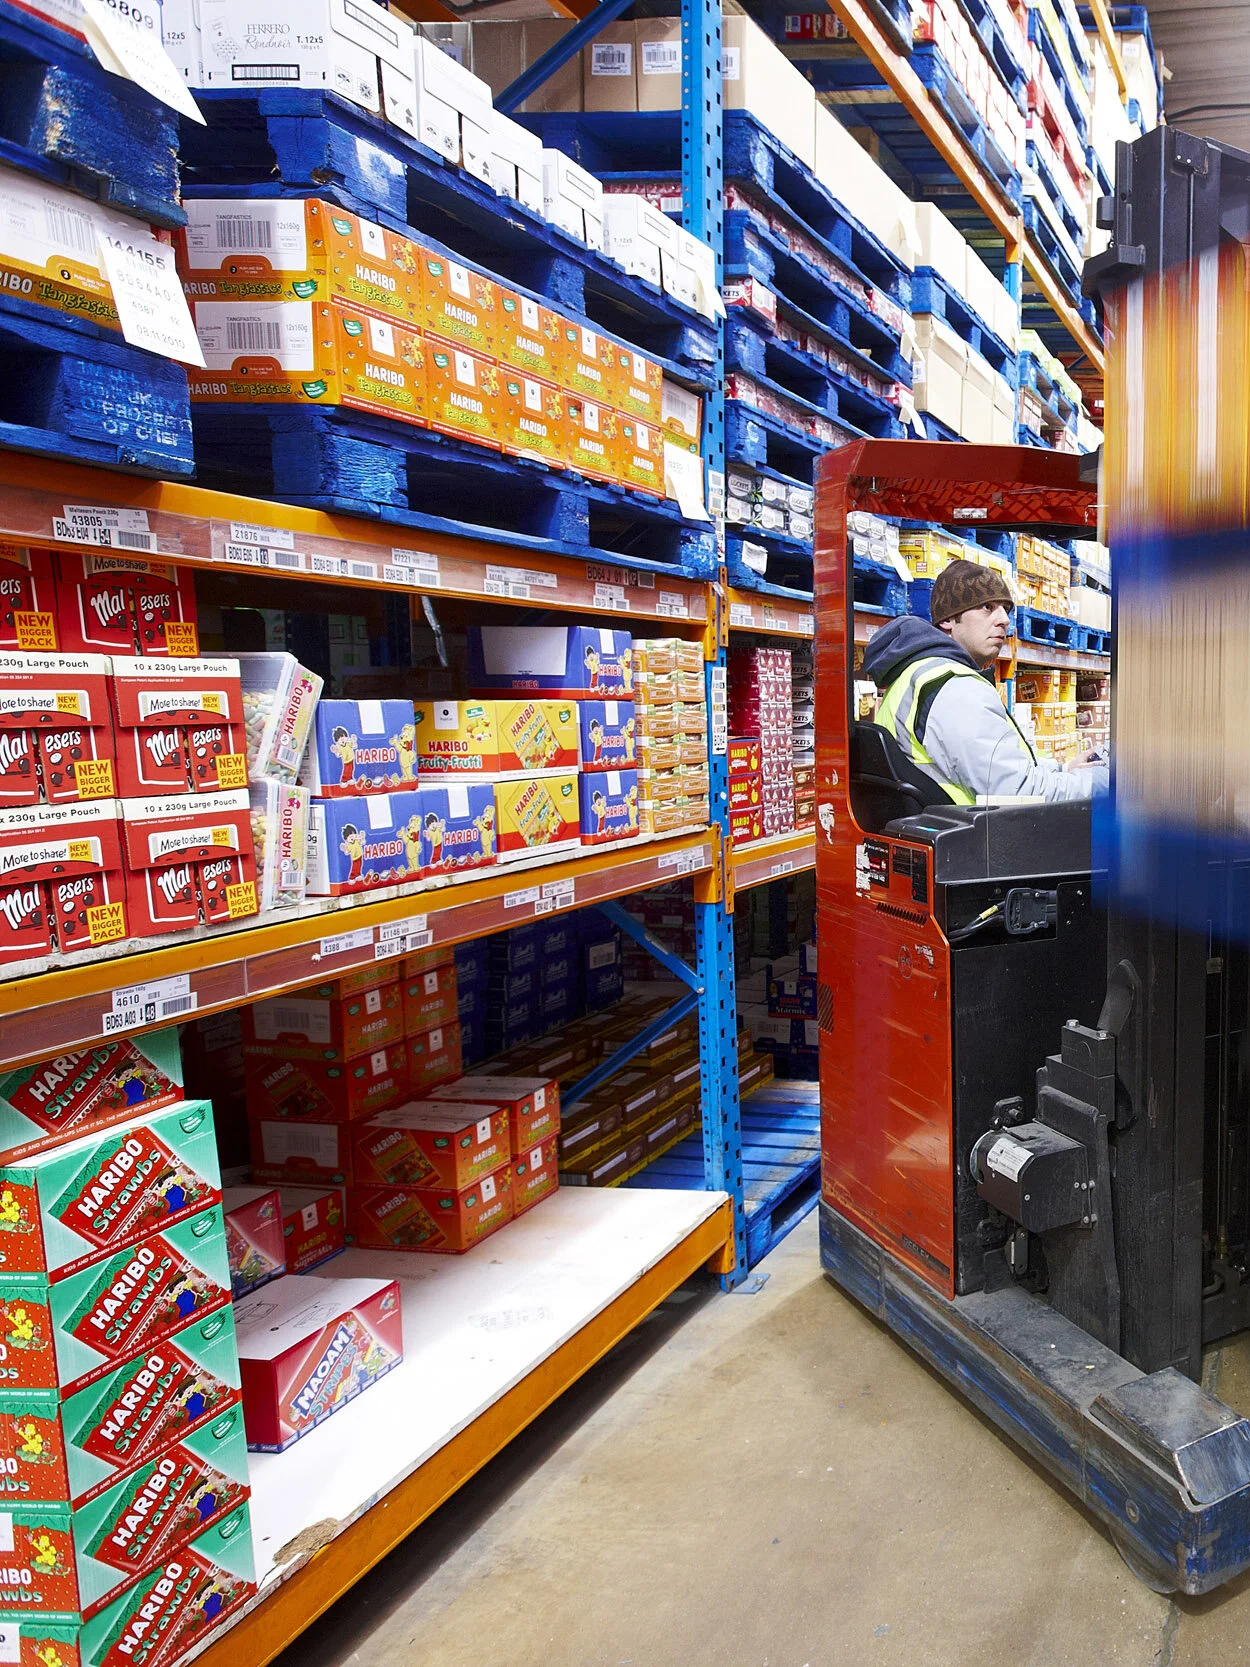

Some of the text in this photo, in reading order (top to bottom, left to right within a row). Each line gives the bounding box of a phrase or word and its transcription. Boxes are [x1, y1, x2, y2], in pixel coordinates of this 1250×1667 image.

[247, 24, 290, 34] FERRERO
[244, 34, 293, 50] Rondnoir
[305, 36, 324, 44] 12x5
[107, 236, 166, 270] 144155
[356, 264, 396, 291] HARIBO
[349, 278, 404, 310] Tangfastics
[444, 302, 478, 327] HARIBO
[516, 336, 544, 357] HARIBO
[365, 362, 404, 388] HARIBO
[188, 382, 292, 396] HARIBO Tangfastics
[357, 377, 413, 406] Tangfastics
[450, 392, 482, 414] HARIBO
[72, 516, 102, 526] 43805
[235, 530, 258, 541] 21876
[18, 613, 50, 627] NEW
[20, 628, 53, 638] BIGGER
[168, 624, 193, 636] NEW
[22, 636, 54, 648] PACK
[168, 636, 194, 646] BIGGER
[170, 644, 196, 654] PACK
[27, 658, 56, 668] Large
[59, 658, 89, 668] Pouch
[155, 664, 176, 672] 230g
[179, 664, 200, 673] Large
[204, 664, 228, 672] Pouch
[58, 695, 76, 704] NEW
[150, 698, 170, 711] More
[179, 697, 200, 708] share!
[284, 686, 304, 734] HARIBO
[510, 703, 536, 737] HARIBO
[514, 713, 544, 750] Fruity-Frutti
[428, 740, 468, 752] HARIBO
[219, 757, 242, 768] NEW
[356, 748, 396, 764] HARIBO
[418, 755, 482, 771] Fruity-Frutti
[78, 762, 108, 776] NEW
[220, 769, 244, 778] BIGGER
[80, 776, 110, 786] BIGGER
[221, 776, 245, 786] PACK
[82, 784, 111, 796] PACK
[168, 802, 188, 814] 230g
[190, 800, 212, 810] Large
[214, 798, 237, 808] Pouch
[514, 781, 538, 816] HARIBO
[9, 806, 100, 824] 230g Large Pouch
[519, 791, 548, 828] Fruity-Frutti
[282, 808, 292, 858] HARIBO
[444, 829, 478, 846] HARIBO
[160, 838, 180, 853] More
[191, 834, 211, 845] share!
[363, 840, 402, 860] HARIBO
[3, 852, 26, 869] More
[40, 848, 67, 860] share!
[230, 884, 253, 897] NEW
[230, 894, 254, 906] BIGGER
[232, 902, 255, 914] PACK
[90, 906, 120, 920] NEW
[92, 919, 122, 932] BIGGER
[94, 928, 124, 941] PACK
[324, 942, 340, 953] 4388
[116, 994, 140, 1008] 4610
[106, 1014, 124, 1030] BD63
[124, 1010, 136, 1026] A03
[44, 1042, 119, 1120] Strawbs
[13, 1147, 26, 1156] KIDS
[28, 1142, 40, 1151] AND
[41, 1130, 76, 1146] GROWN-UPS
[76, 1124, 89, 1134] LOVE
[106, 1116, 116, 1124] THE
[116, 1110, 132, 1120] HAPPY
[134, 1103, 150, 1113] WORLD
[158, 1093, 176, 1104] HARIBO
[77, 1138, 143, 1218] HARIBO
[93, 1149, 162, 1234] Strawbs
[90, 1248, 154, 1330] HARIBO
[105, 1256, 172, 1345] Strawbs
[299, 1329, 350, 1410] MAOAM
[309, 1344, 358, 1417] STRIPES
[100, 1355, 164, 1441] HARIBO
[114, 1361, 182, 1454] Strawbs
[111, 1458, 176, 1548] HARIBO
[127, 1463, 194, 1560] Strawbs
[118, 1562, 182, 1656] HARIBO
[132, 1565, 200, 1667] Strawbs
